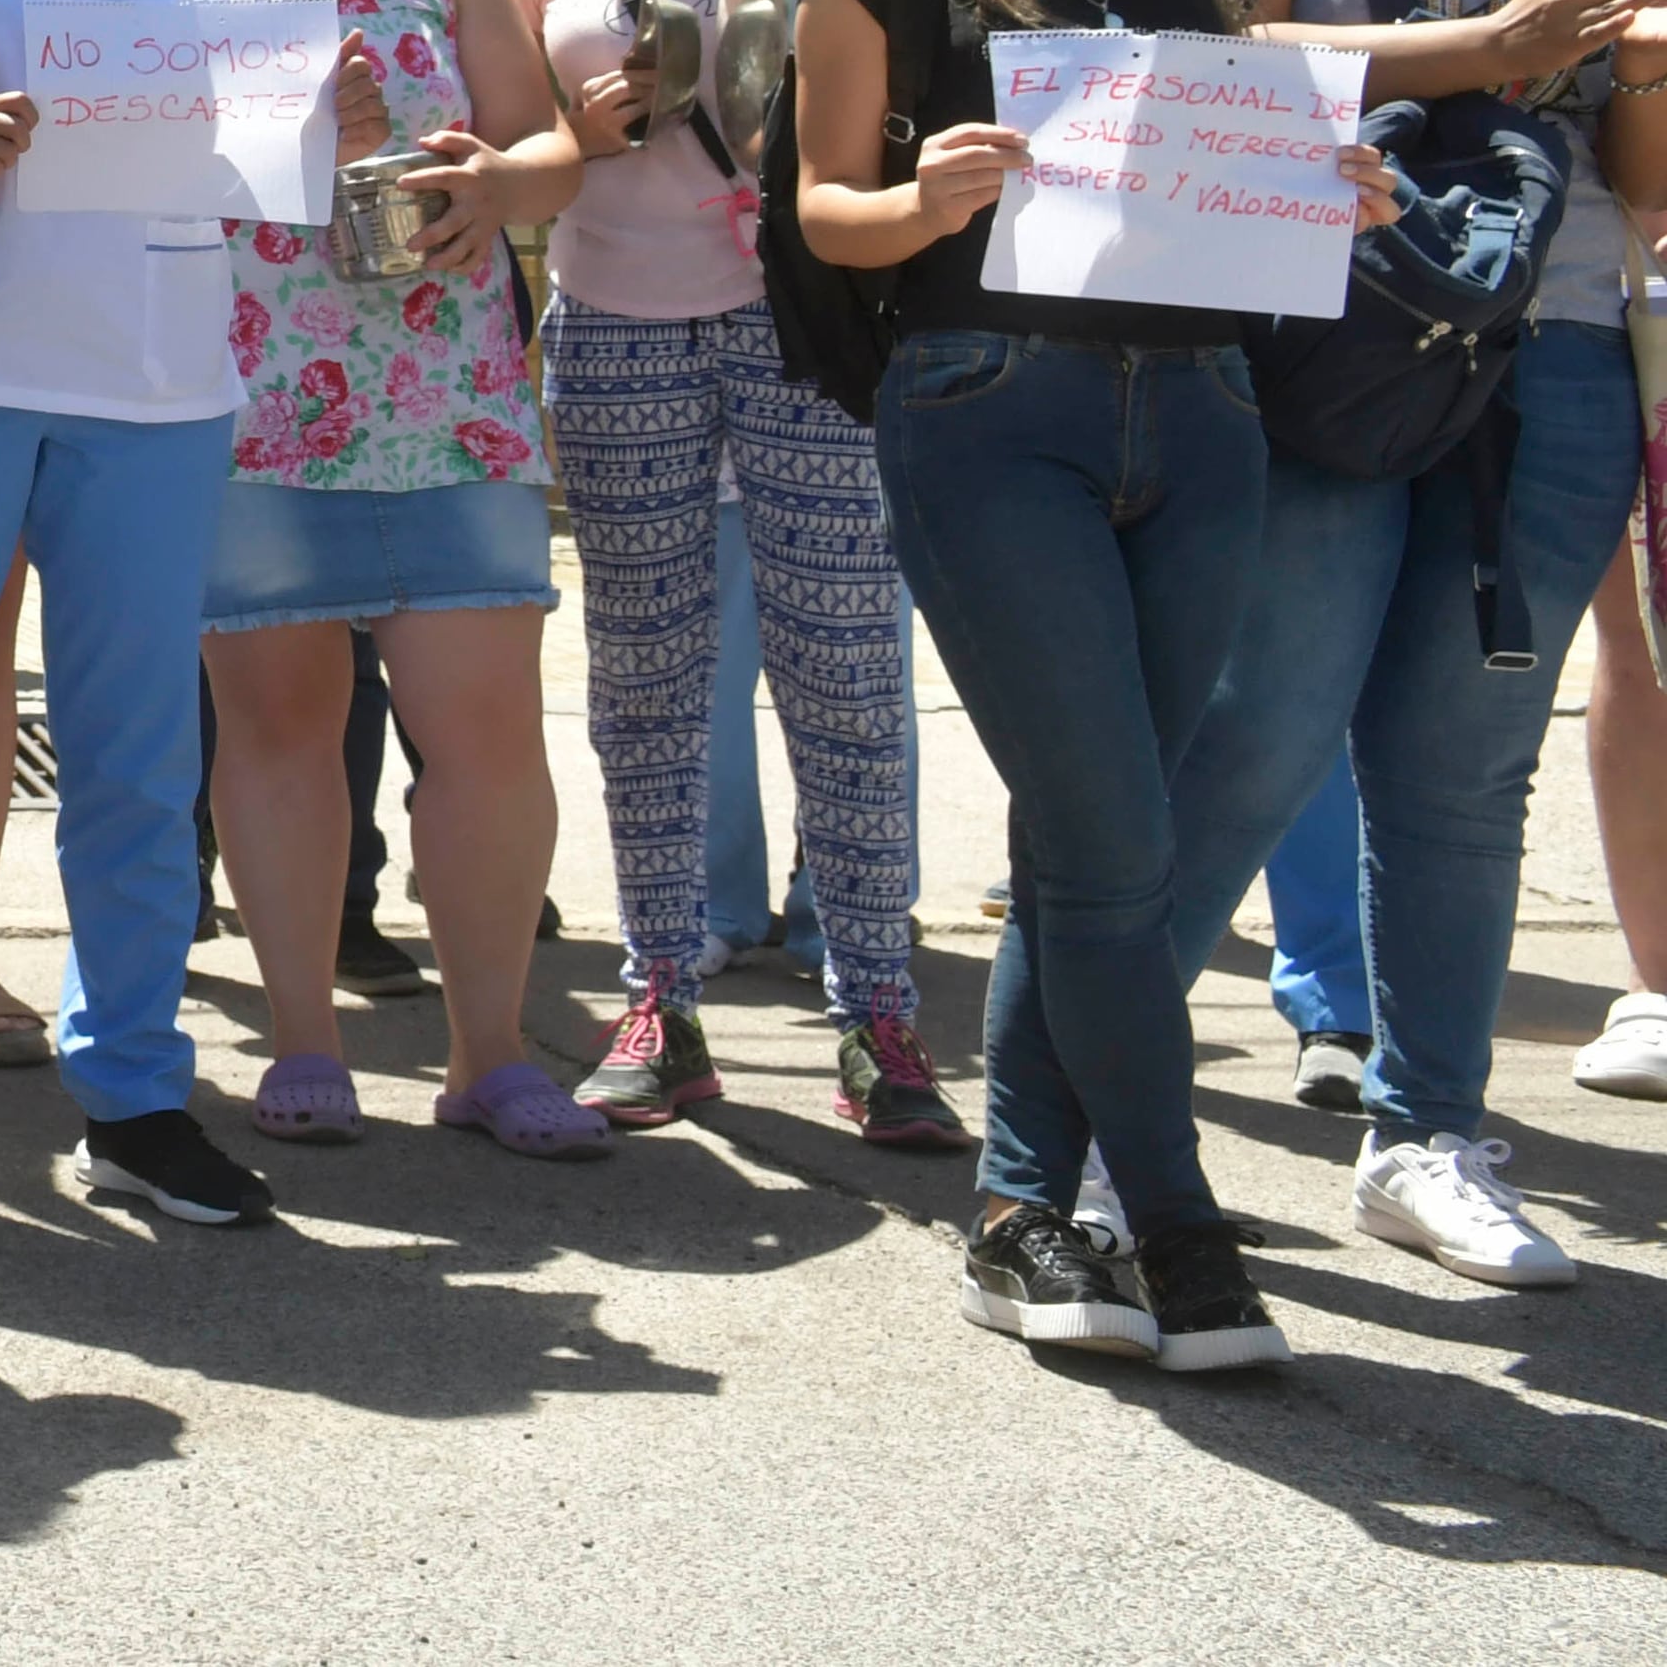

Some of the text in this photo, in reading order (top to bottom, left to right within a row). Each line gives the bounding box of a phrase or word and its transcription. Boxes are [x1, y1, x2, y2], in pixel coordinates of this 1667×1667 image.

[126, 36, 309, 75] SOMOS
[51, 92, 308, 127] DESCARTE
[1009, 66, 1361, 122] EL PERSONAL DE
[1062, 118, 1334, 163] SALUD MERECE
[1020, 162, 1355, 227] RESPETO Y VALORACION
